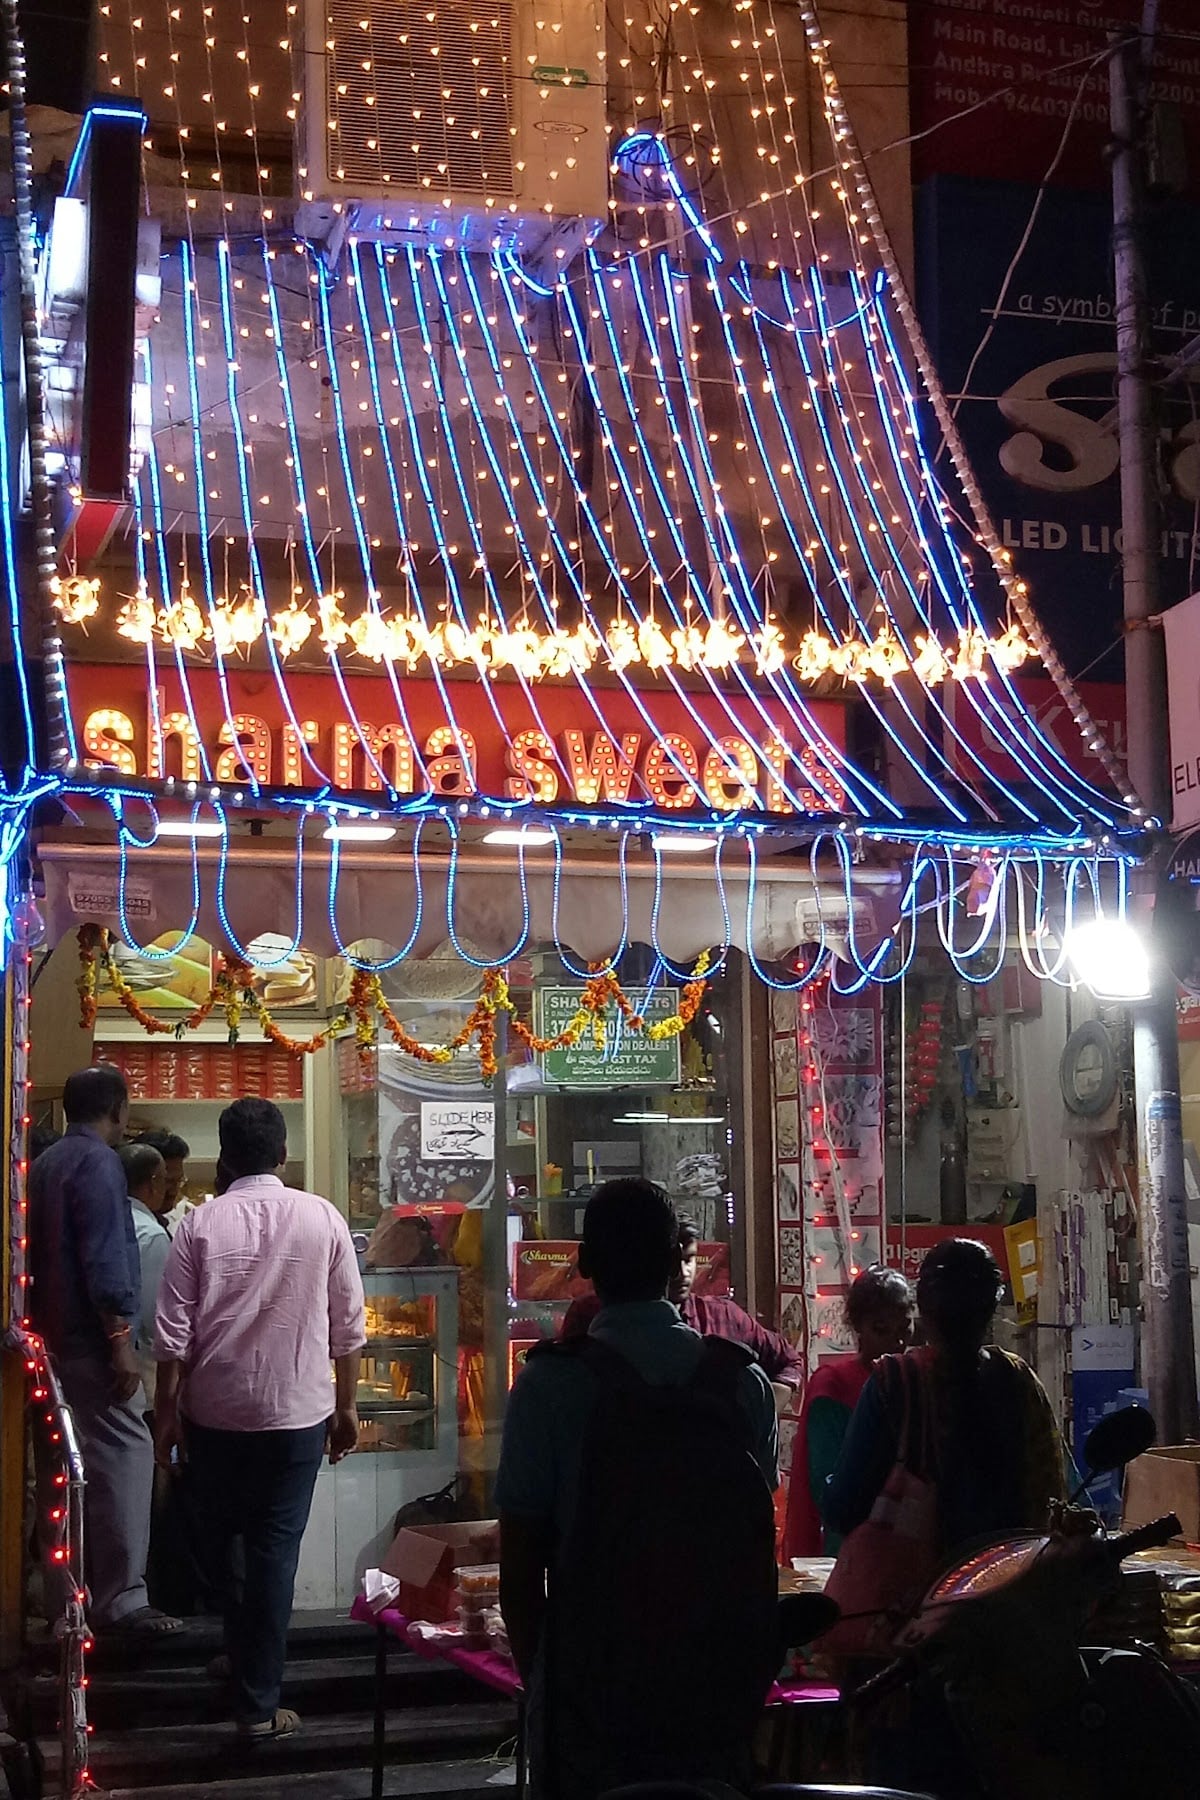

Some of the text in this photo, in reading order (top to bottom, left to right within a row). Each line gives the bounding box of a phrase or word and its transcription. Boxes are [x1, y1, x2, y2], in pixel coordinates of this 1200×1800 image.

[934, 18, 986, 45] Main
[993, 28, 1053, 56] Road,
[934, 50, 1015, 80] Andhra
[1018, 293, 1033, 312] a
[1042, 294, 1119, 326] symb
[1002, 518, 1200, 560] LED LIT
[82, 684, 846, 814] sharma sweets
[551, 996, 671, 1009] SHA EETS
[611, 1054, 657, 1064] GST TAX
[430, 1112, 468, 1126] SLIDE
[527, 1250, 569, 1261] Sharma
